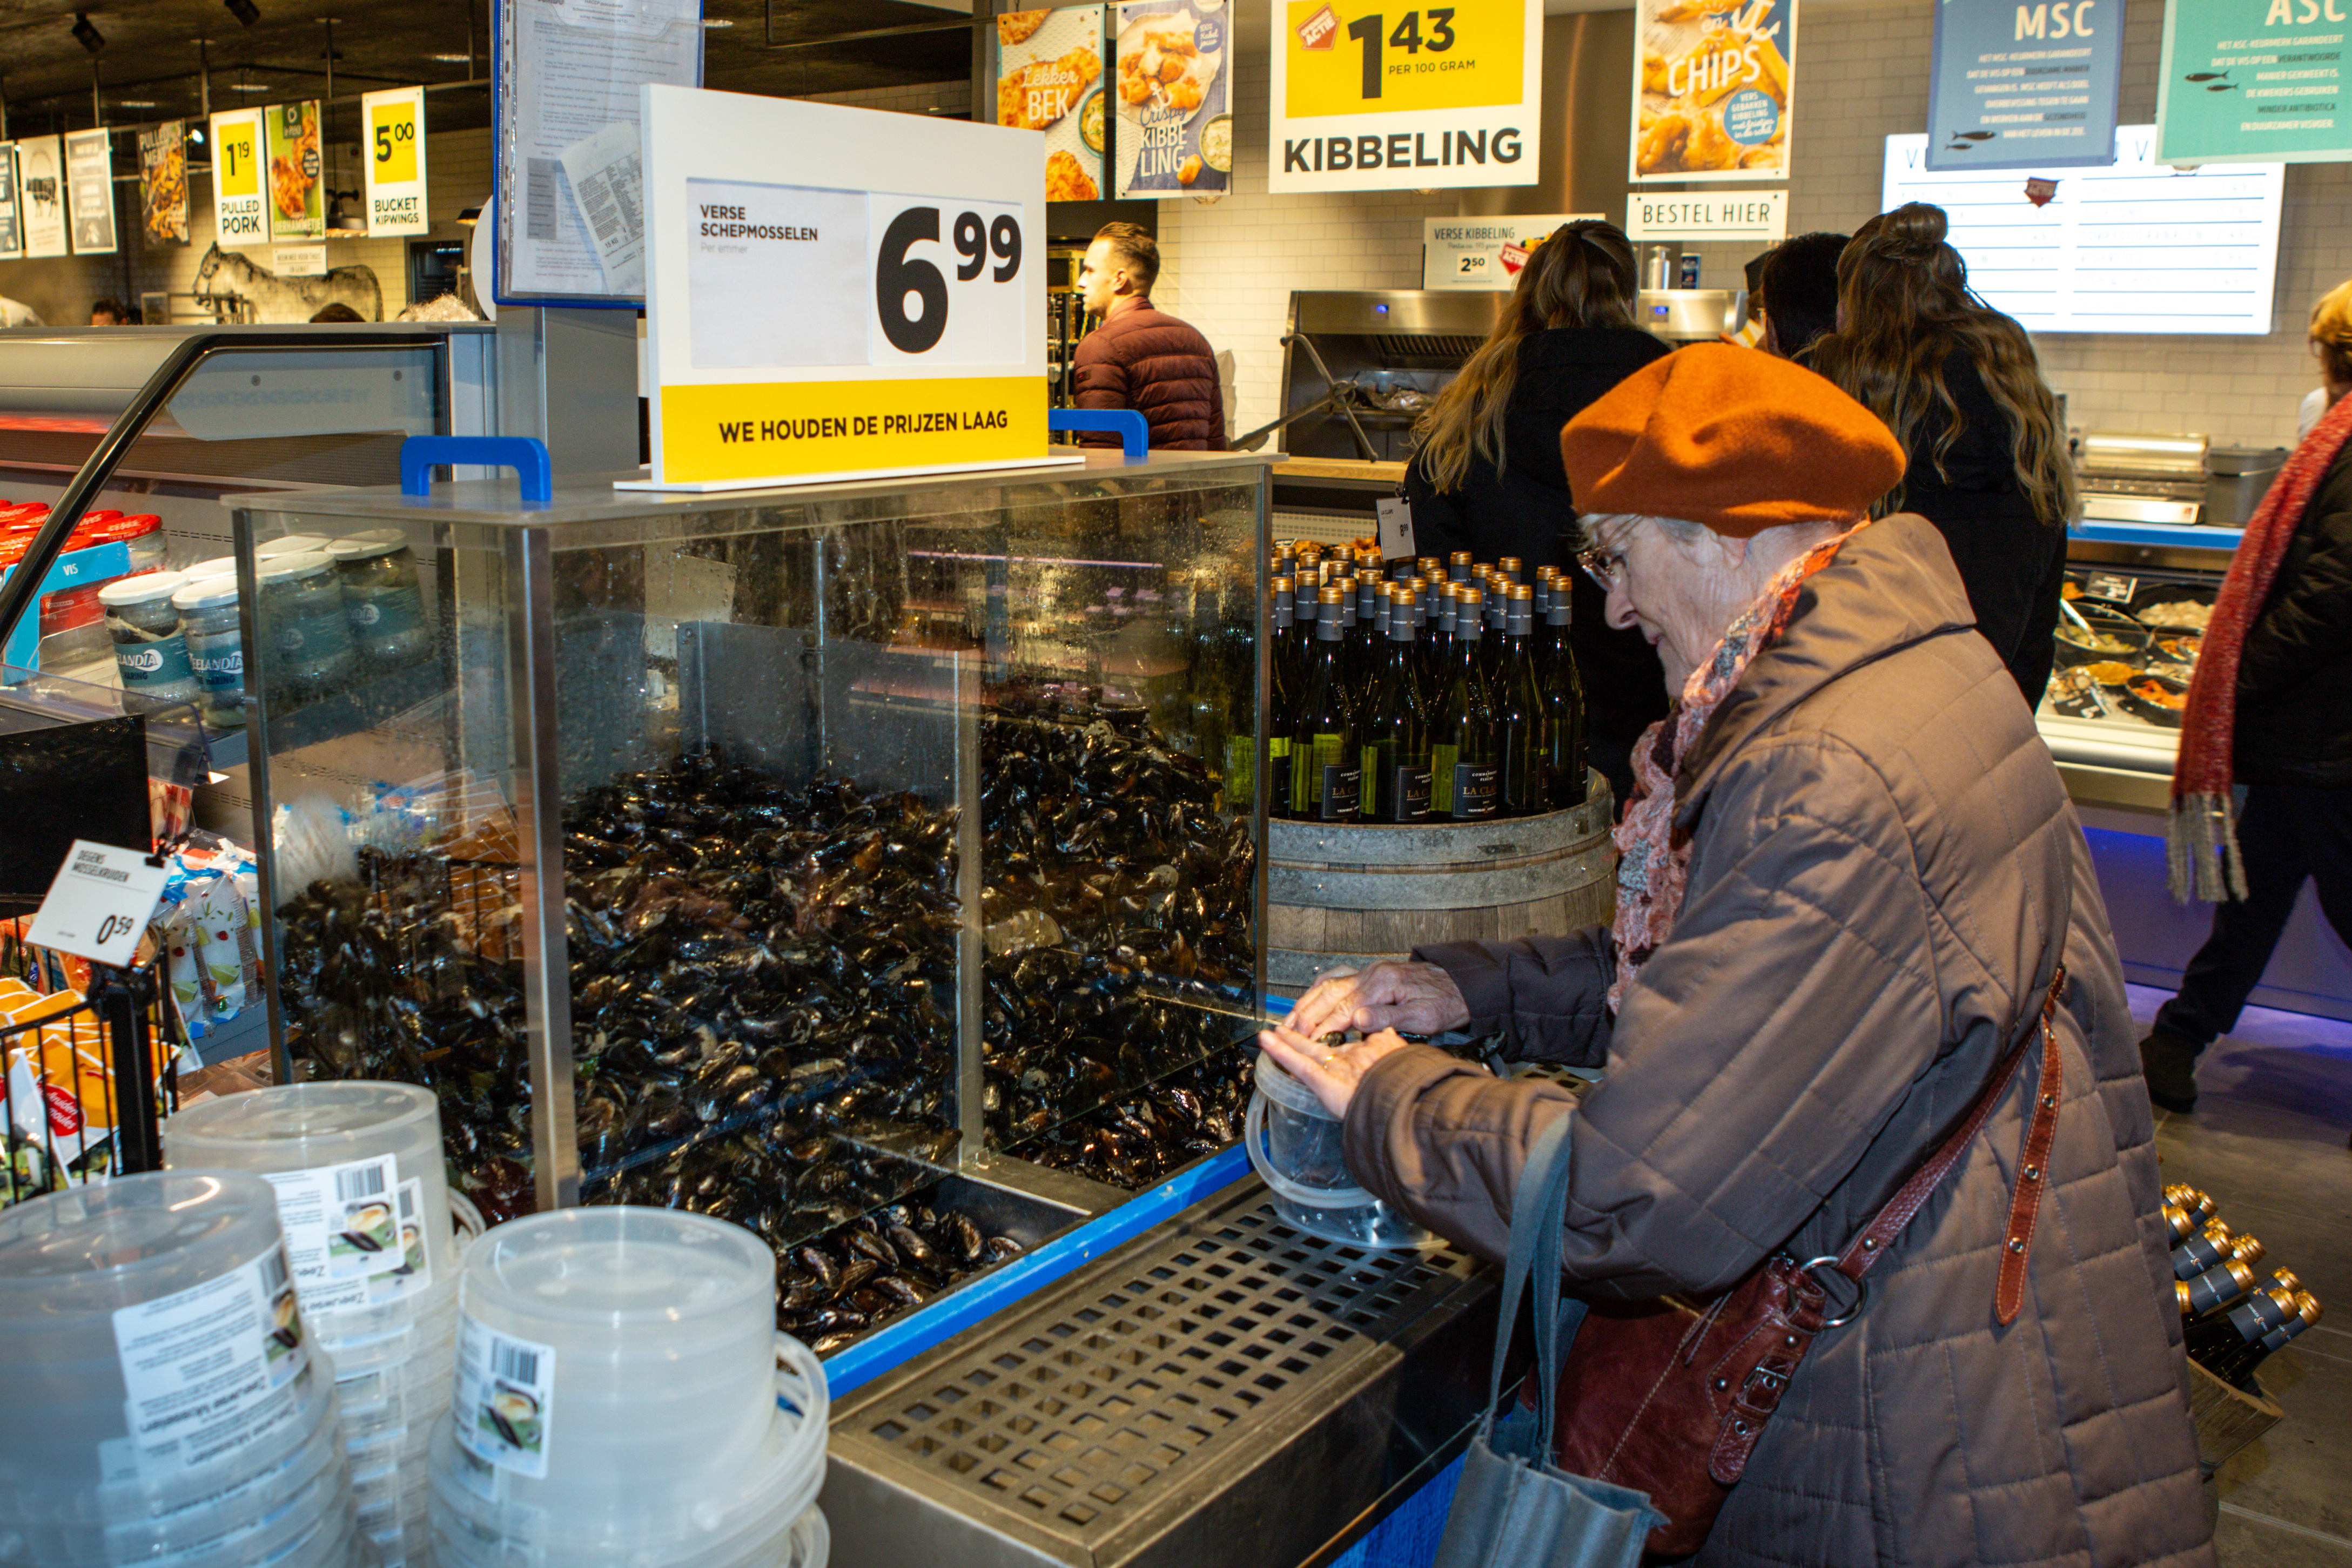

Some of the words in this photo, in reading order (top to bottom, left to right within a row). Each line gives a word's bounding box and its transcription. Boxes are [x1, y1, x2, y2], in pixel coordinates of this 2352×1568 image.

[2015, 1, 2095, 41] MSC
[2266, 0, 2348, 26] ASC
[1305, 15, 1336, 46] ACTIE
[1022, 65, 1079, 88] Lekker
[1389, 64, 1411, 75] PER
[1415, 63, 1436, 73] 100
[1440, 59, 1476, 71] GRAM
[1668, 44, 1761, 97] CHIPS
[1028, 88, 1070, 121] BEK
[1731, 99, 1768, 112] GEBAKKEN
[1740, 91, 1758, 102] VERS
[1140, 105, 1188, 127] Crispy
[1732, 108, 1769, 121] KIBBELING
[1140, 123, 1188, 149] KIBBE
[1283, 127, 1523, 173] KIBBELING
[1140, 147, 1186, 177] LING
[221, 199, 259, 214] PULLED
[375, 197, 418, 212] BUCKET
[700, 204, 747, 220] VERSE
[1643, 204, 1713, 224] BESTEL
[1723, 202, 1770, 224] HIER
[222, 214, 260, 234] PORK
[375, 212, 419, 225] KIPWINGS
[700, 223, 818, 241] SCHEPMOSSELEN
[1435, 227, 1463, 239] VERSE
[1466, 226, 1515, 239] KIBBELING
[701, 242, 715, 254] Per
[718, 243, 748, 254] emmer
[719, 421, 755, 444] WE
[762, 416, 848, 442] HOUDEN
[854, 415, 879, 436] DE
[884, 412, 958, 434] PRIJZEN
[963, 410, 1009, 430] LAAG
[63, 563, 78, 576] VIS
